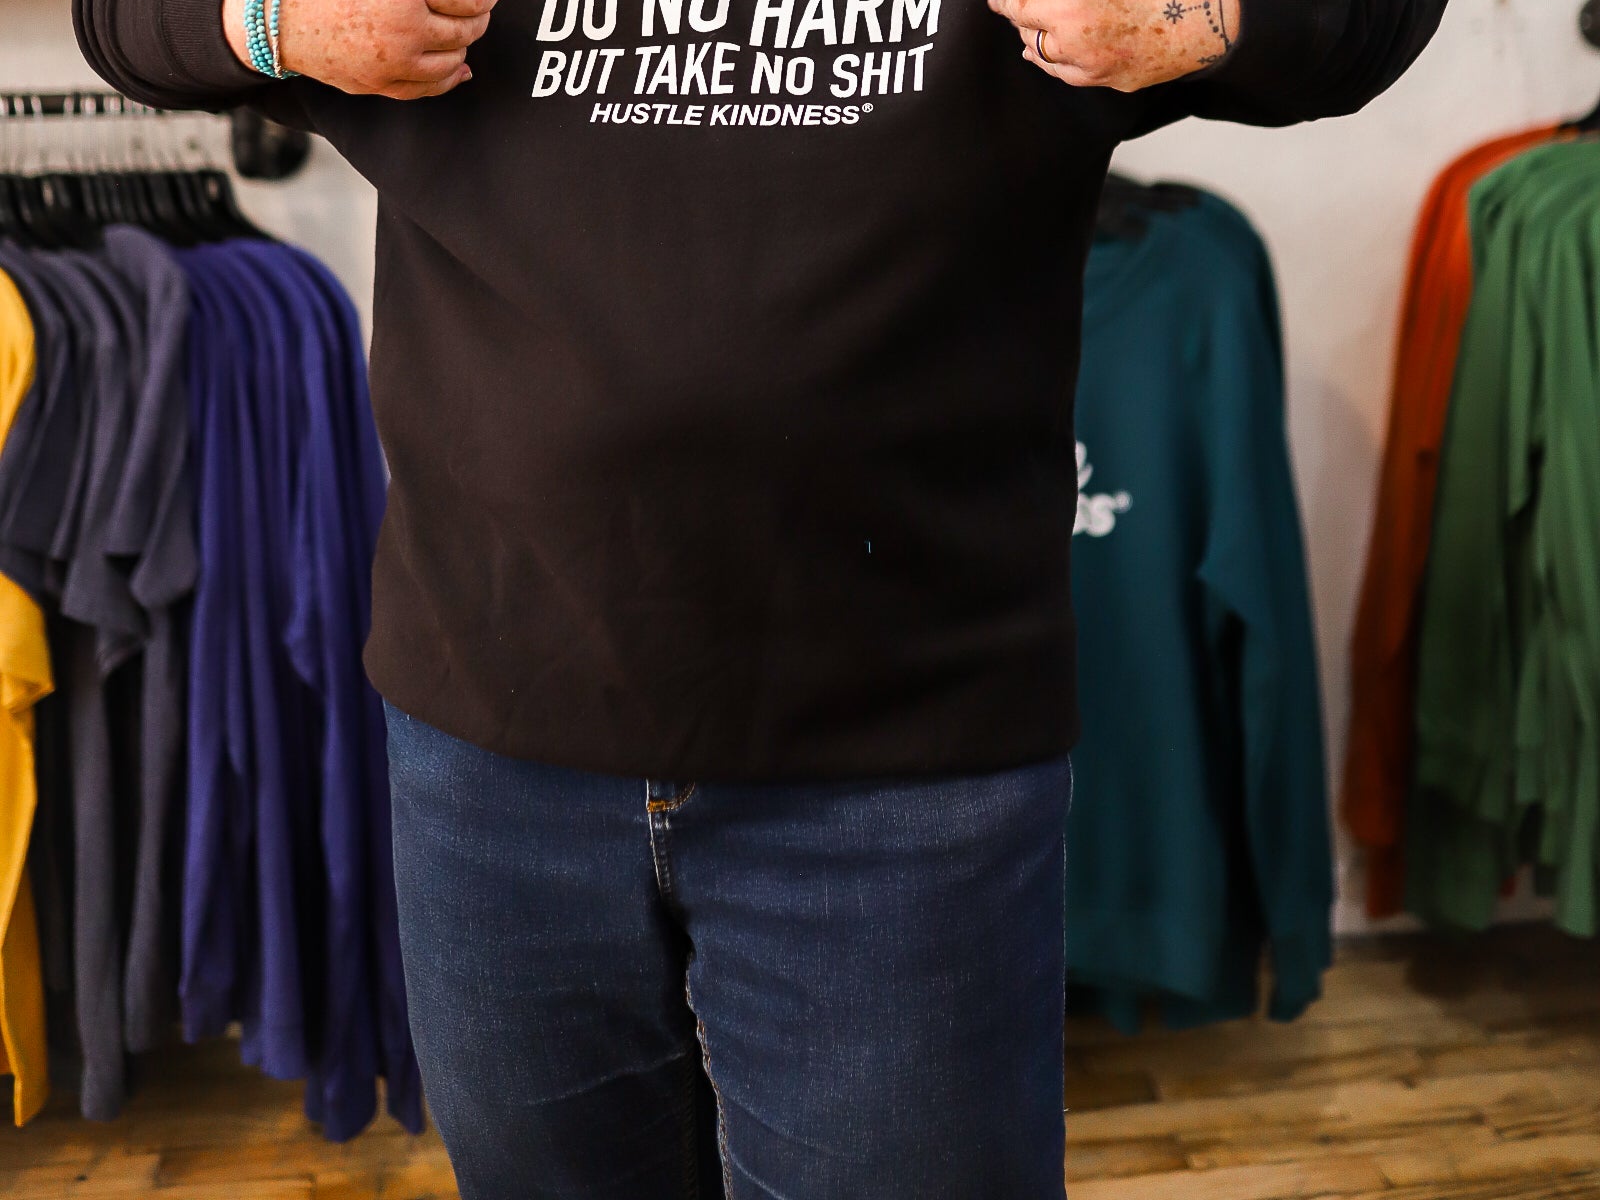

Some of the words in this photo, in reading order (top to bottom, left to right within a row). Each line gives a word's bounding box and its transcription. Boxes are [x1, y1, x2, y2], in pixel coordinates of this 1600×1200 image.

[532, 48, 626, 98] BUT
[633, 41, 741, 95] TAKE
[750, 51, 815, 96] NO
[830, 43, 934, 99] SHIT
[590, 102, 706, 125] HUSTLE
